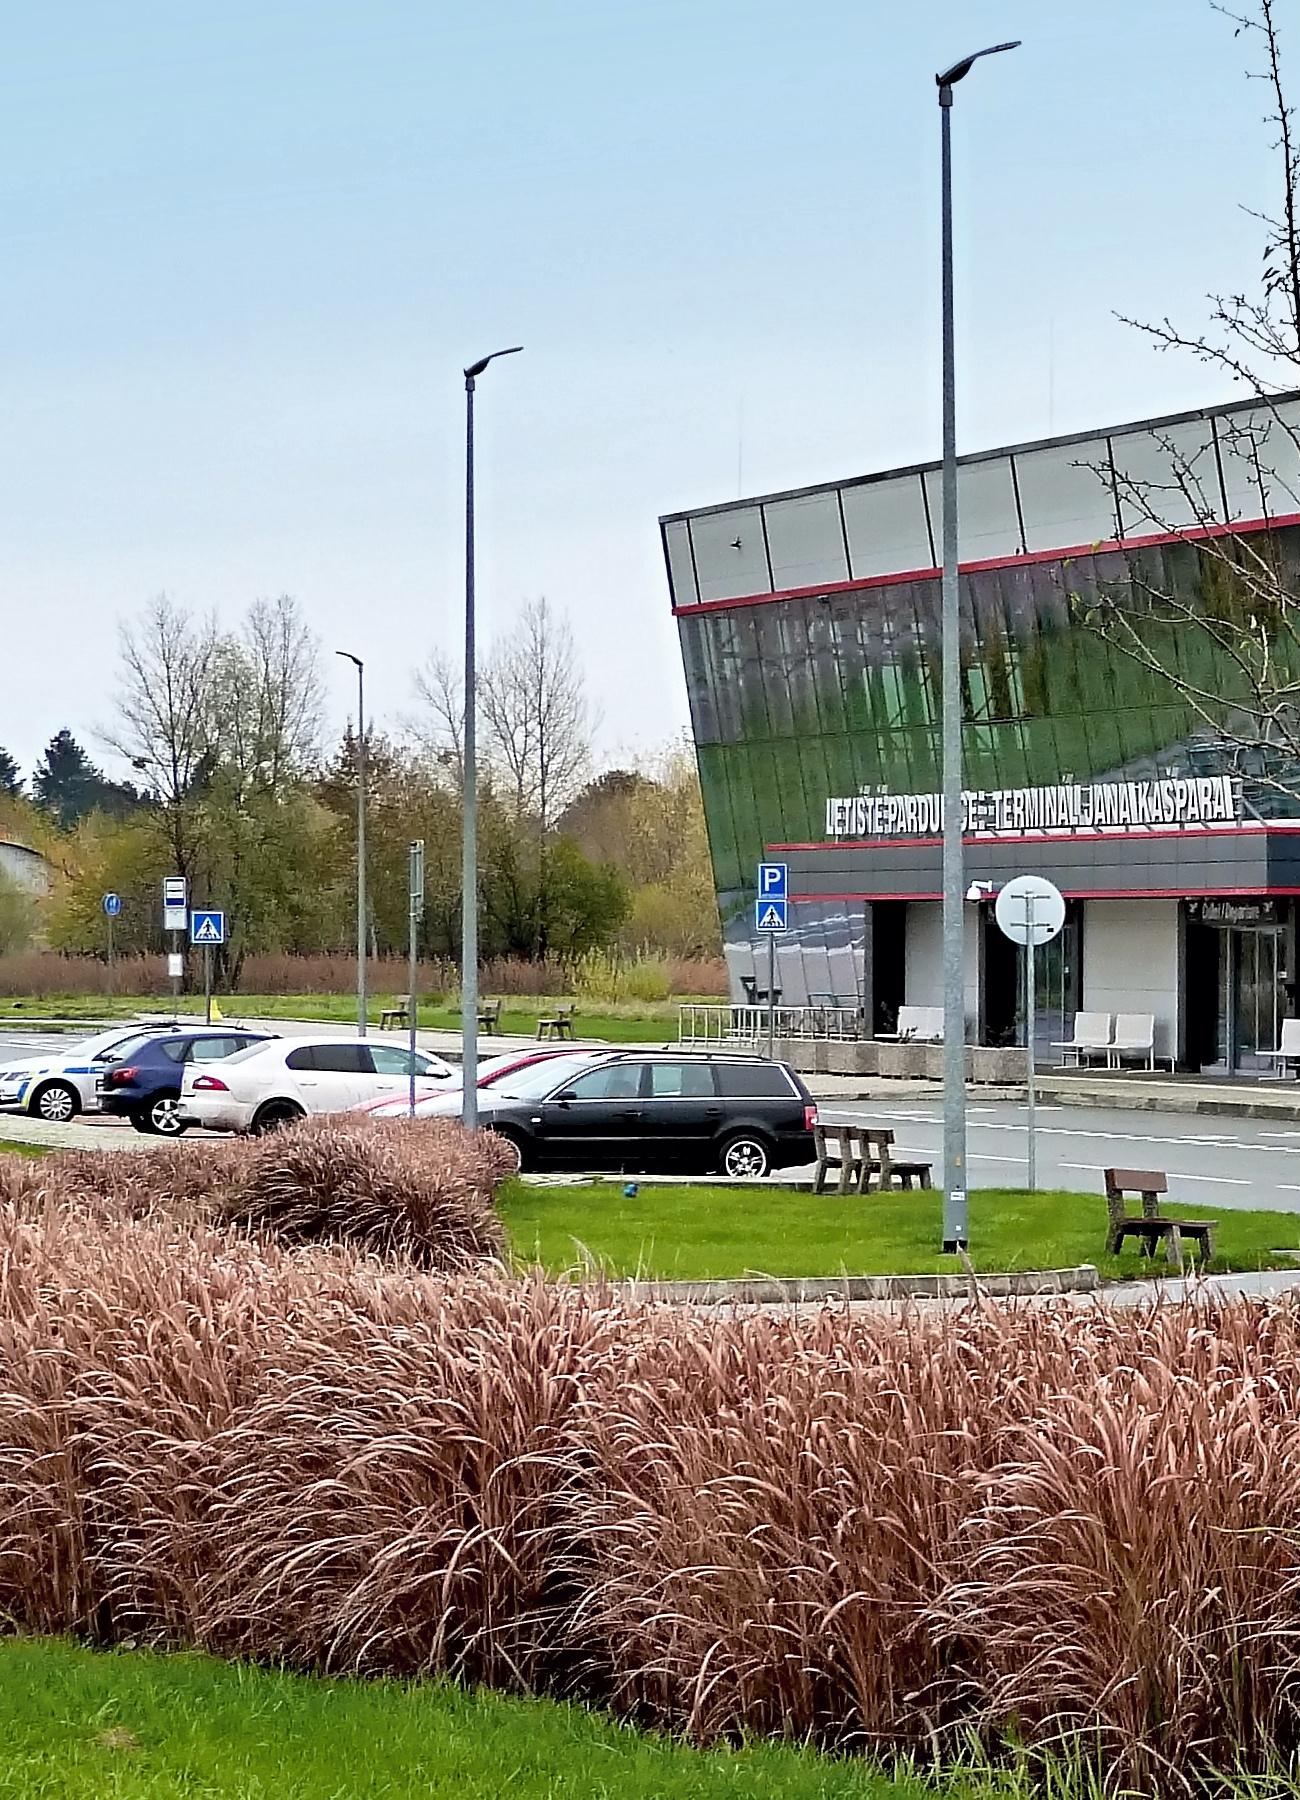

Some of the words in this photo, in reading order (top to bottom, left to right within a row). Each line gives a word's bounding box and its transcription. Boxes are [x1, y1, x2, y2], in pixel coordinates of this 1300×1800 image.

[887, 790, 979, 833] PARDUCE
[1083, 782, 1130, 826] JANA
[764, 868, 781, 892] P
